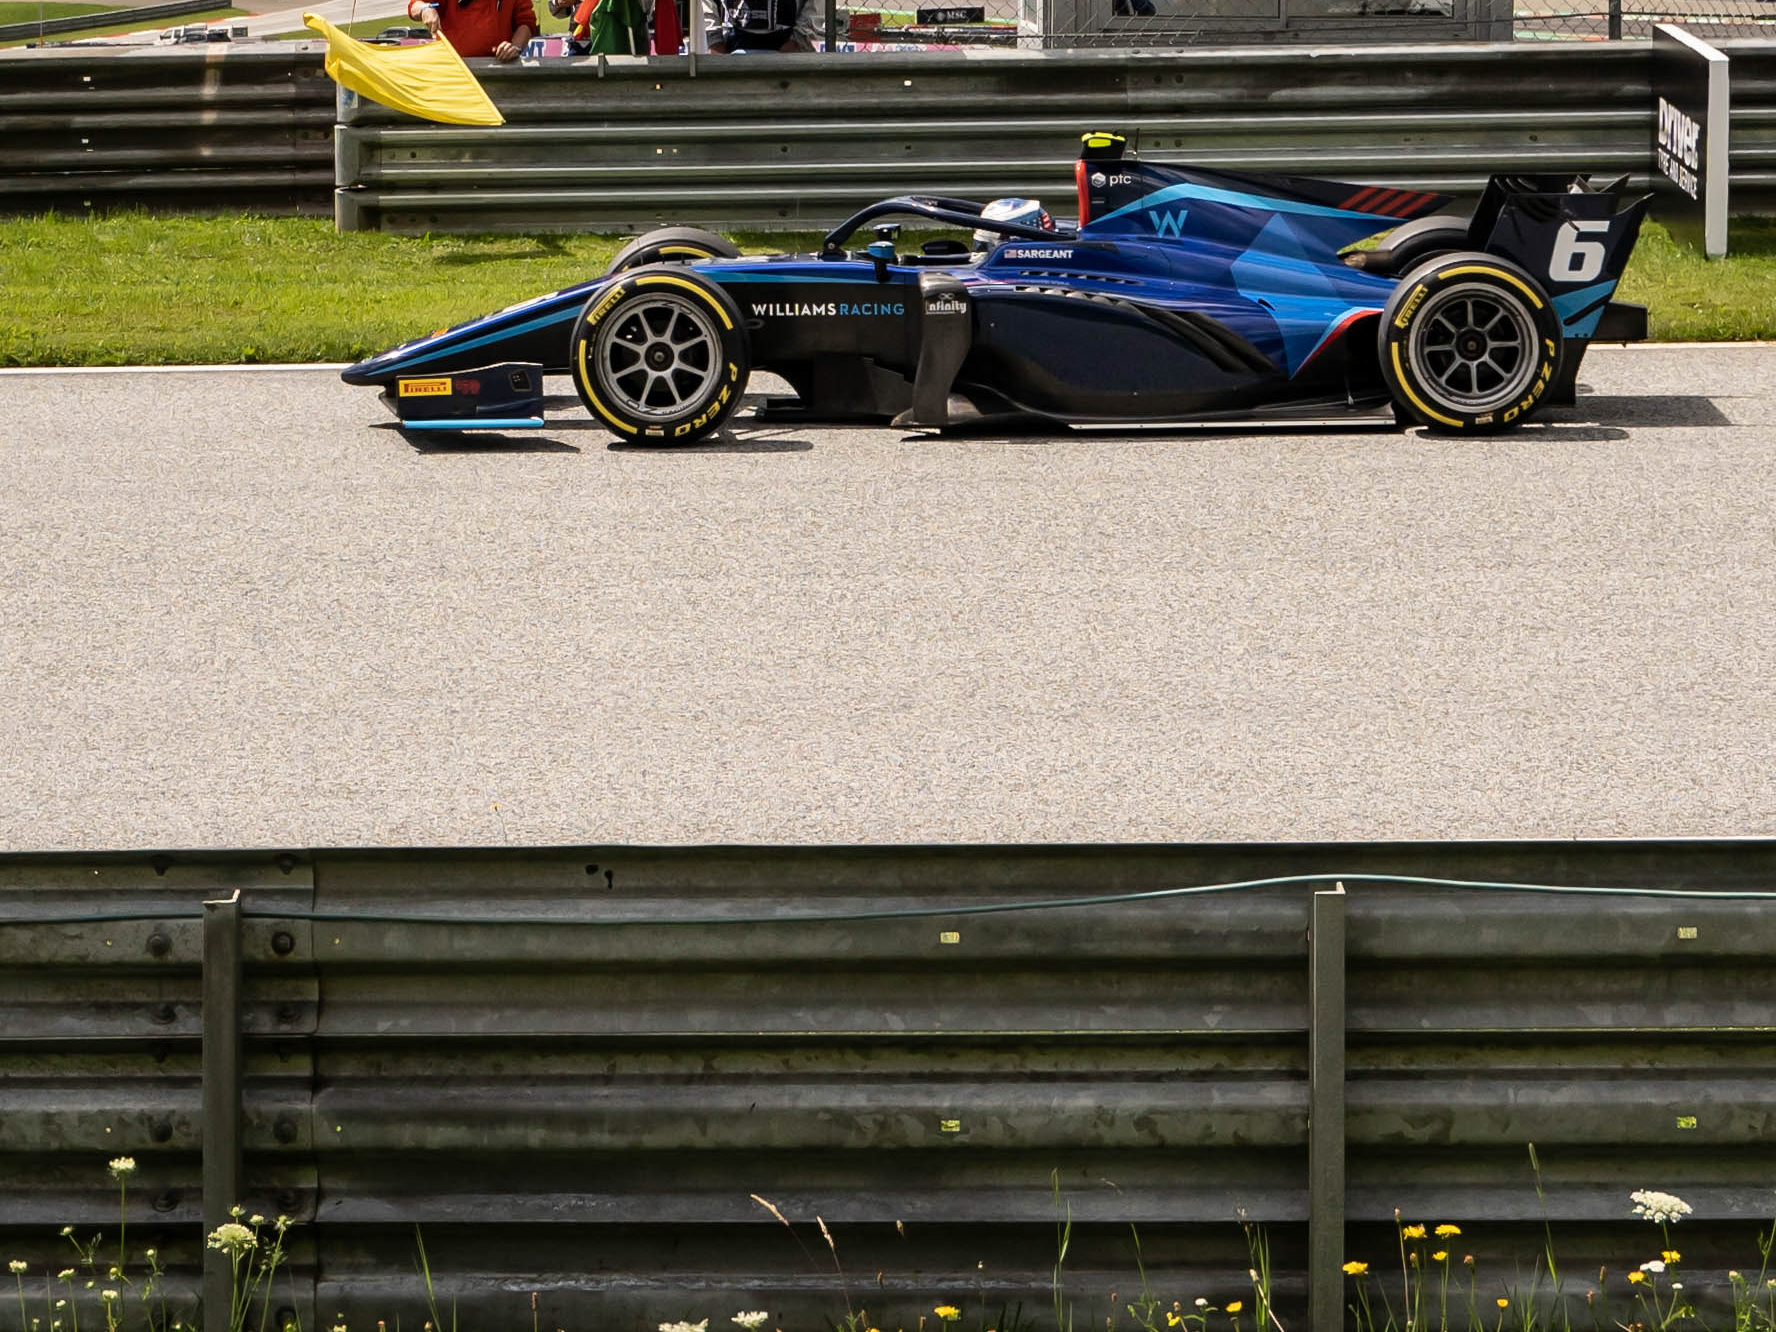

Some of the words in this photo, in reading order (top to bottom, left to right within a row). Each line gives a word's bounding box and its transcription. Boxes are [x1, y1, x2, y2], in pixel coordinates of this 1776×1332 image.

[946, 10, 967, 20] MSC
[1109, 173, 1132, 187] ptc
[1017, 249, 1074, 259] SARGEANT
[1549, 221, 1610, 282] 6
[752, 303, 837, 317] WILLIAMS
[839, 303, 905, 316] RACING
[404, 381, 447, 394] PIRELLI
[1503, 362, 1553, 423] ZERO
[674, 385, 732, 437] ZERO
